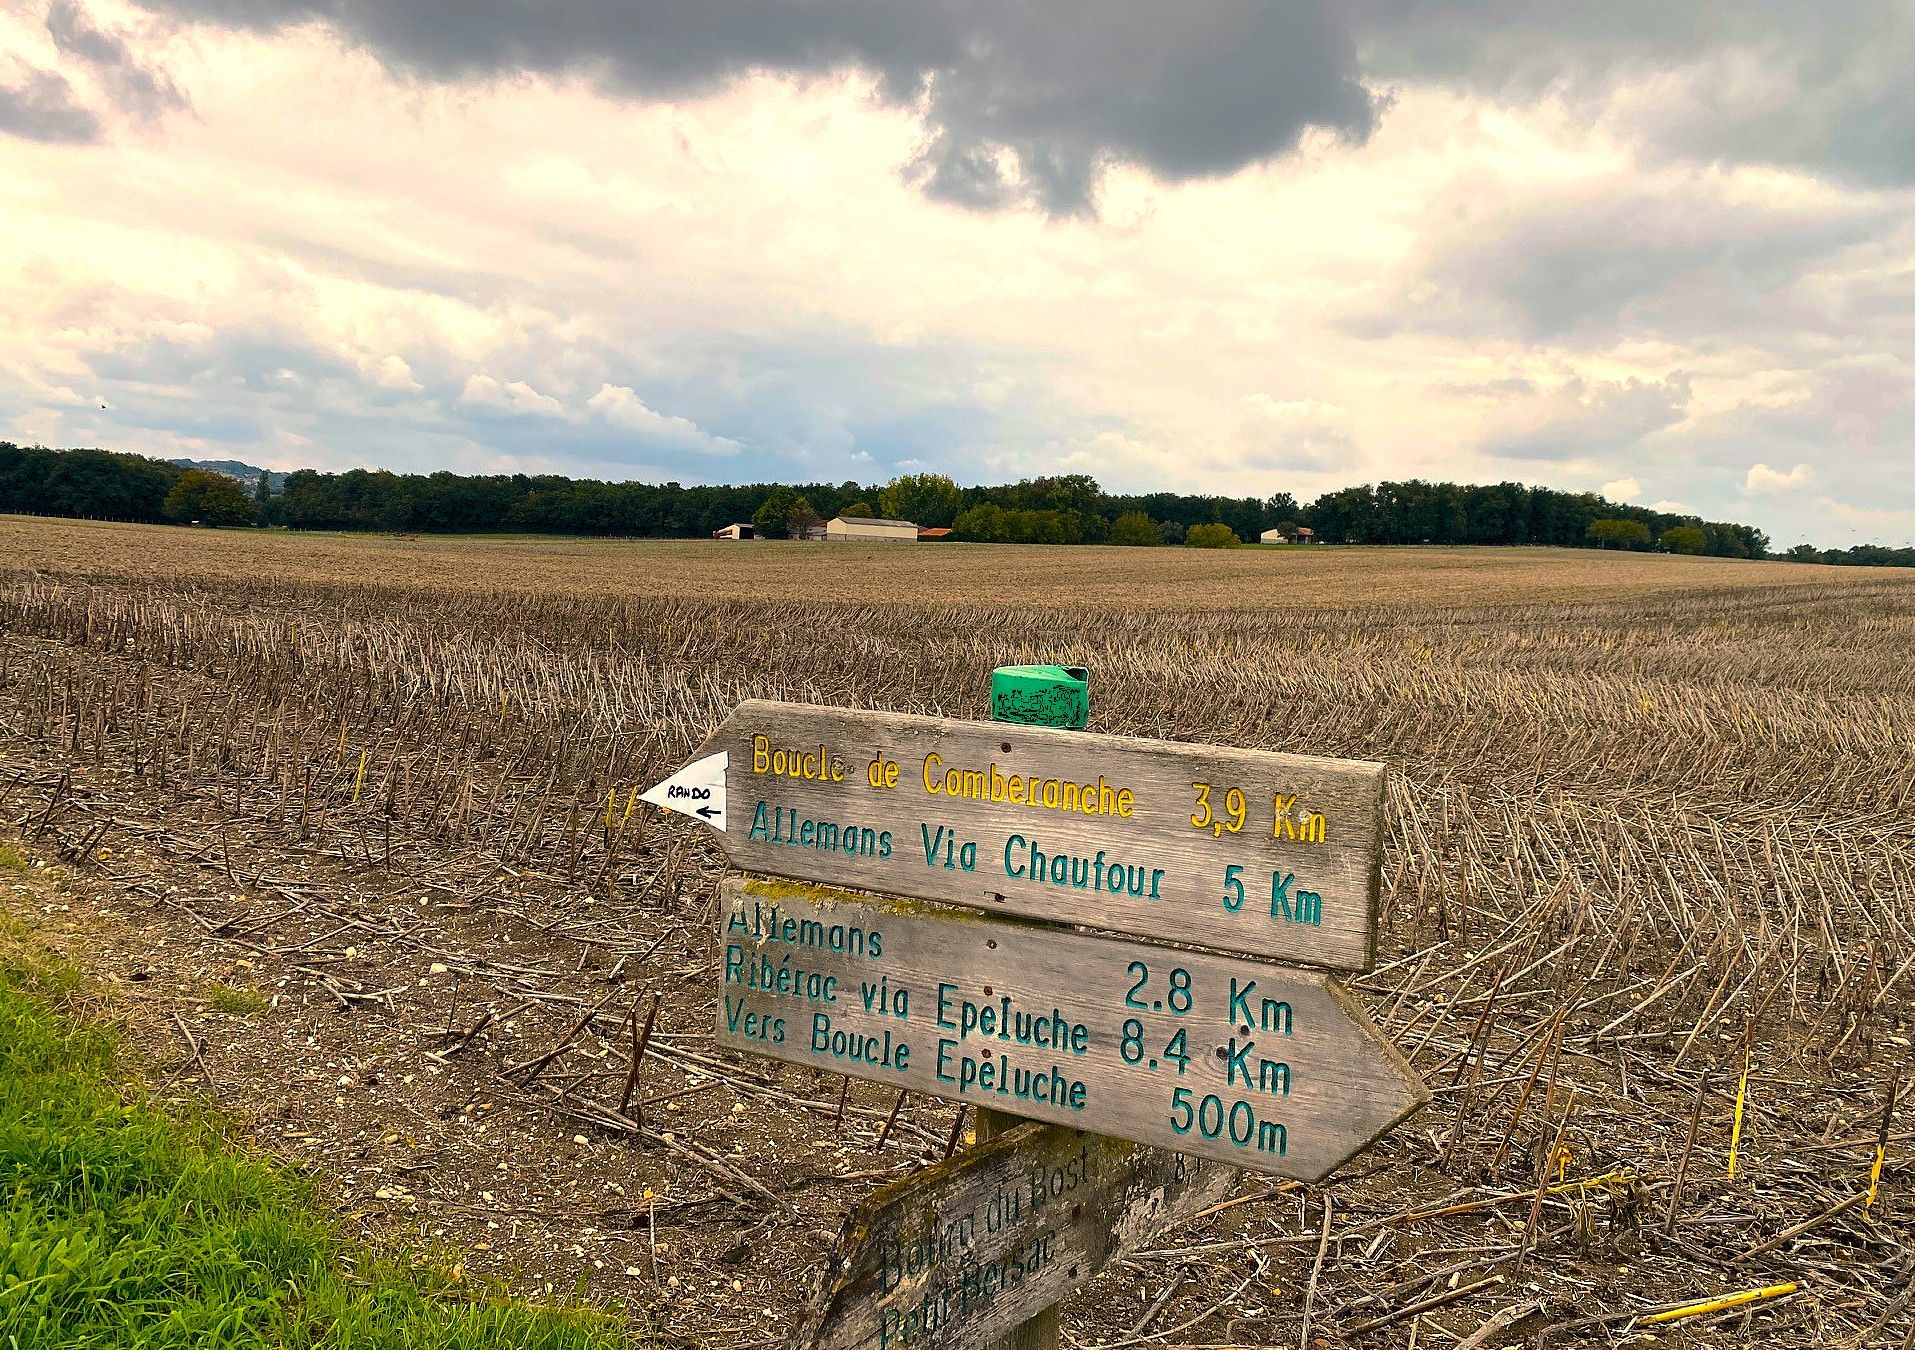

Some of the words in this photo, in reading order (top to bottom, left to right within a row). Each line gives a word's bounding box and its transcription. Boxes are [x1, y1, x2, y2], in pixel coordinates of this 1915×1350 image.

[667, 784, 711, 800] RANDO
[752, 732, 845, 783] Boucle
[867, 750, 900, 789] de
[922, 751, 1136, 819] Comberanche
[1190, 782, 1247, 838] 3,9
[1273, 791, 1327, 844] Km
[748, 800, 894, 860] Allemans
[920, 822, 978, 873] Via
[1003, 834, 1166, 901] Chaufour
[1222, 864, 1246, 914] 5
[1270, 870, 1323, 928] Km
[725, 944, 838, 1004] Ribérac
[861, 975, 910, 1019] via
[936, 982, 1089, 1056] Epeluche
[1119, 1018, 1192, 1076] 8.4
[1226, 1037, 1292, 1097] Km
[727, 897, 883, 961] Allemans
[1125, 960, 1194, 1015] 2.8
[1229, 977, 1293, 1036] Km
[724, 992, 787, 1045] Vers
[810, 1012, 911, 1072] Boucle
[935, 1038, 1088, 1112] Epeluche
[1170, 1086, 1288, 1158] 500m
[880, 1211, 977, 1296] Bourg
[987, 1184, 1021, 1234] du
[1030, 1144, 1088, 1209] Bost
[960, 1229, 1056, 1319] Bersac
